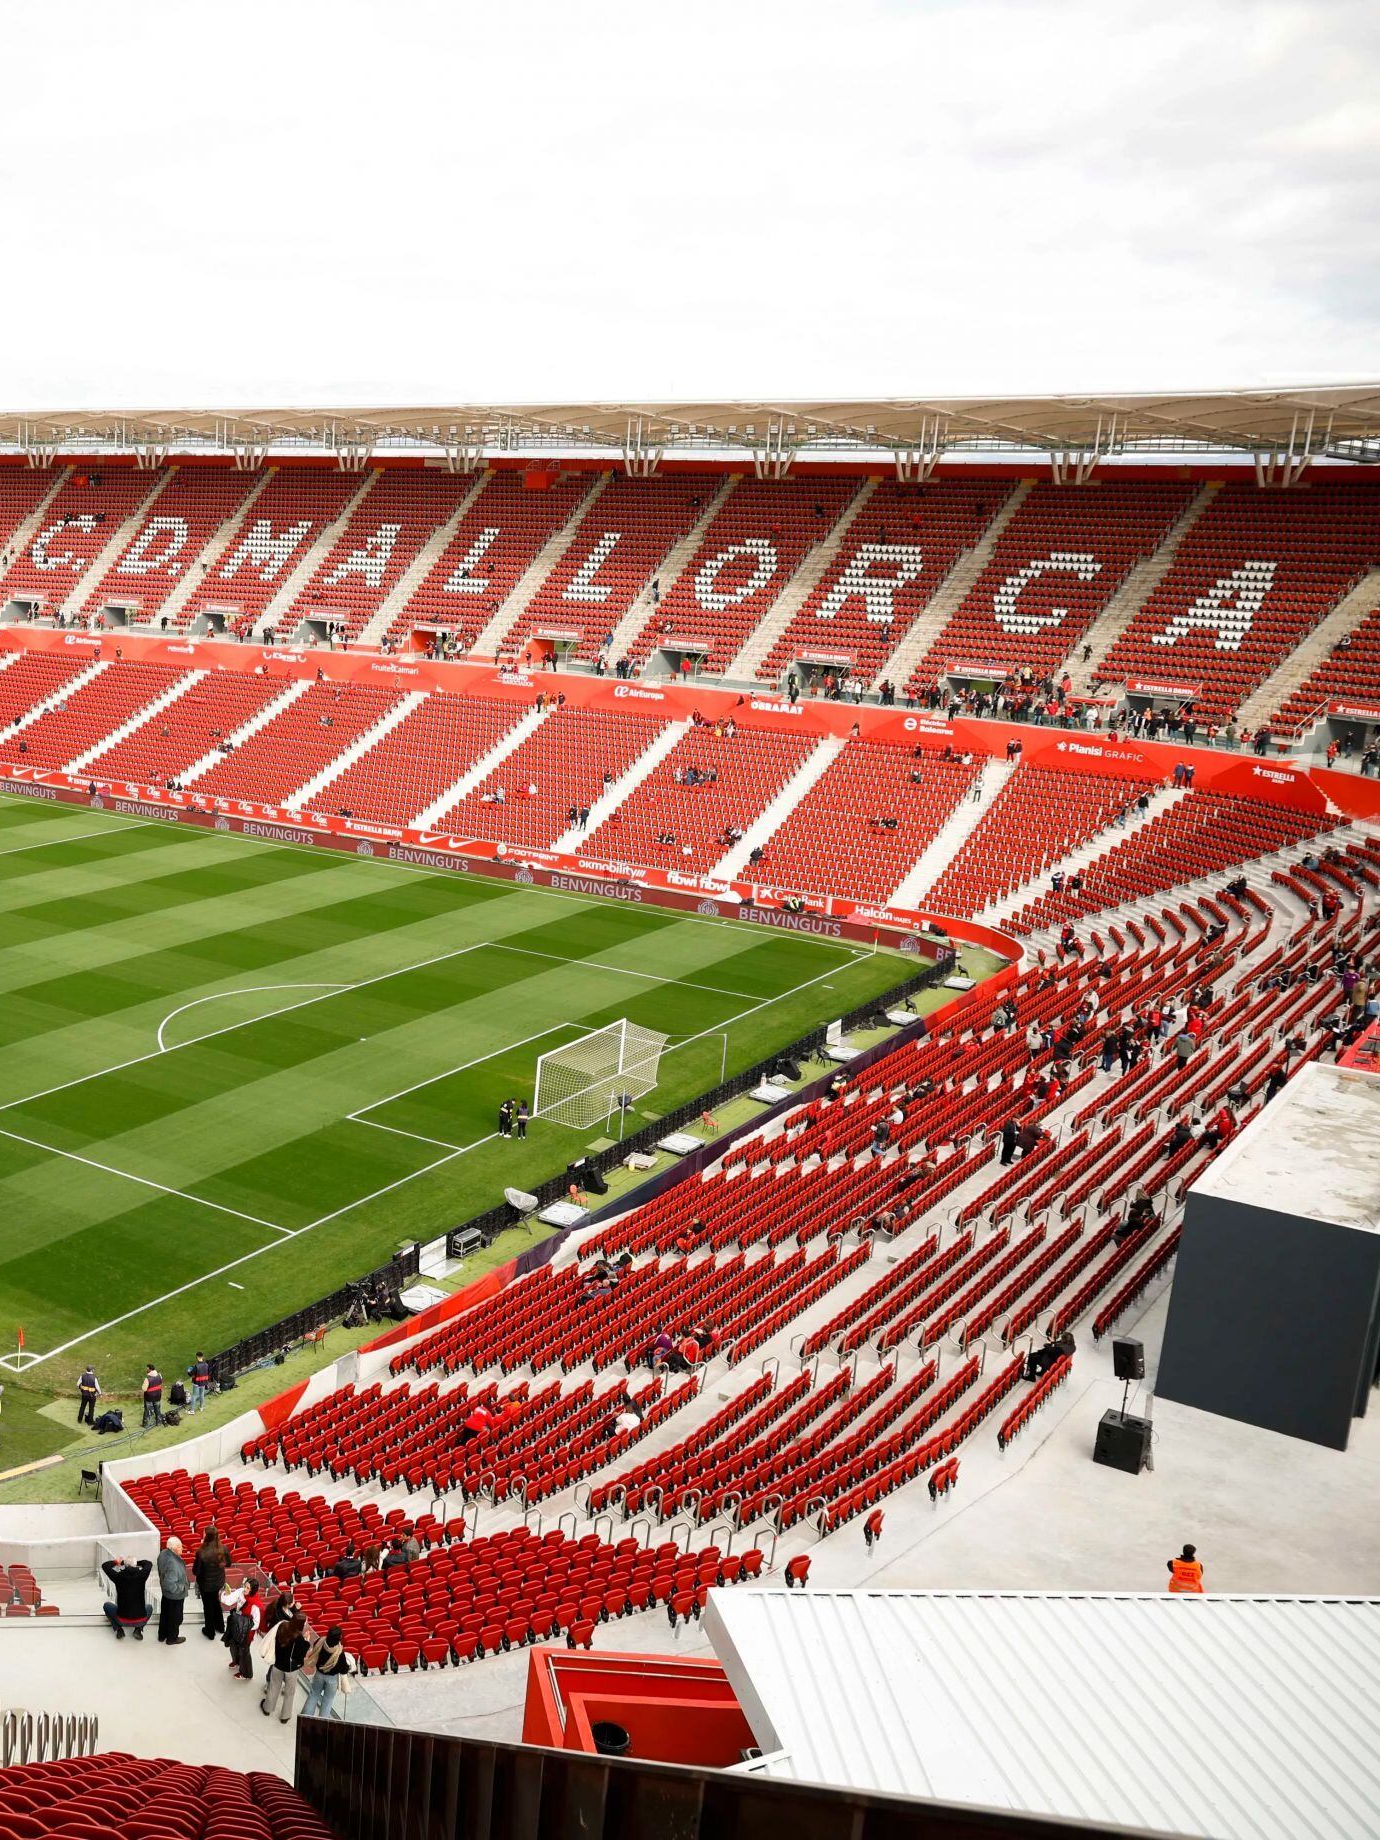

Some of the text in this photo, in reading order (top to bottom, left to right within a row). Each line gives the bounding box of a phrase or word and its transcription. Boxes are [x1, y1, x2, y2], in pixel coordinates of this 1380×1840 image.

[961, 666, 988, 674] ESTRELLA
[629, 688, 664, 701] AirEuropa
[1143, 684, 1172, 693] ESTRELLA
[750, 701, 804, 715] OBRAMAT
[1068, 743, 1103, 757] Planisi
[1261, 769, 1295, 783] ESTRELLA
[0, 781, 57, 800] BENVINGUTS
[115, 800, 179, 821] BENVINGUTS
[243, 822, 314, 845] BENVINGUTS
[353, 823, 403, 838] ESTRELLA DAMM
[388, 847, 469, 872] BENVINGUTS
[508, 848, 560, 862] FOOTPRINT
[667, 870, 697, 887] fibwi
[551, 875, 642, 902] BENVINGUTS
[739, 907, 841, 937] BENVINGUTS
